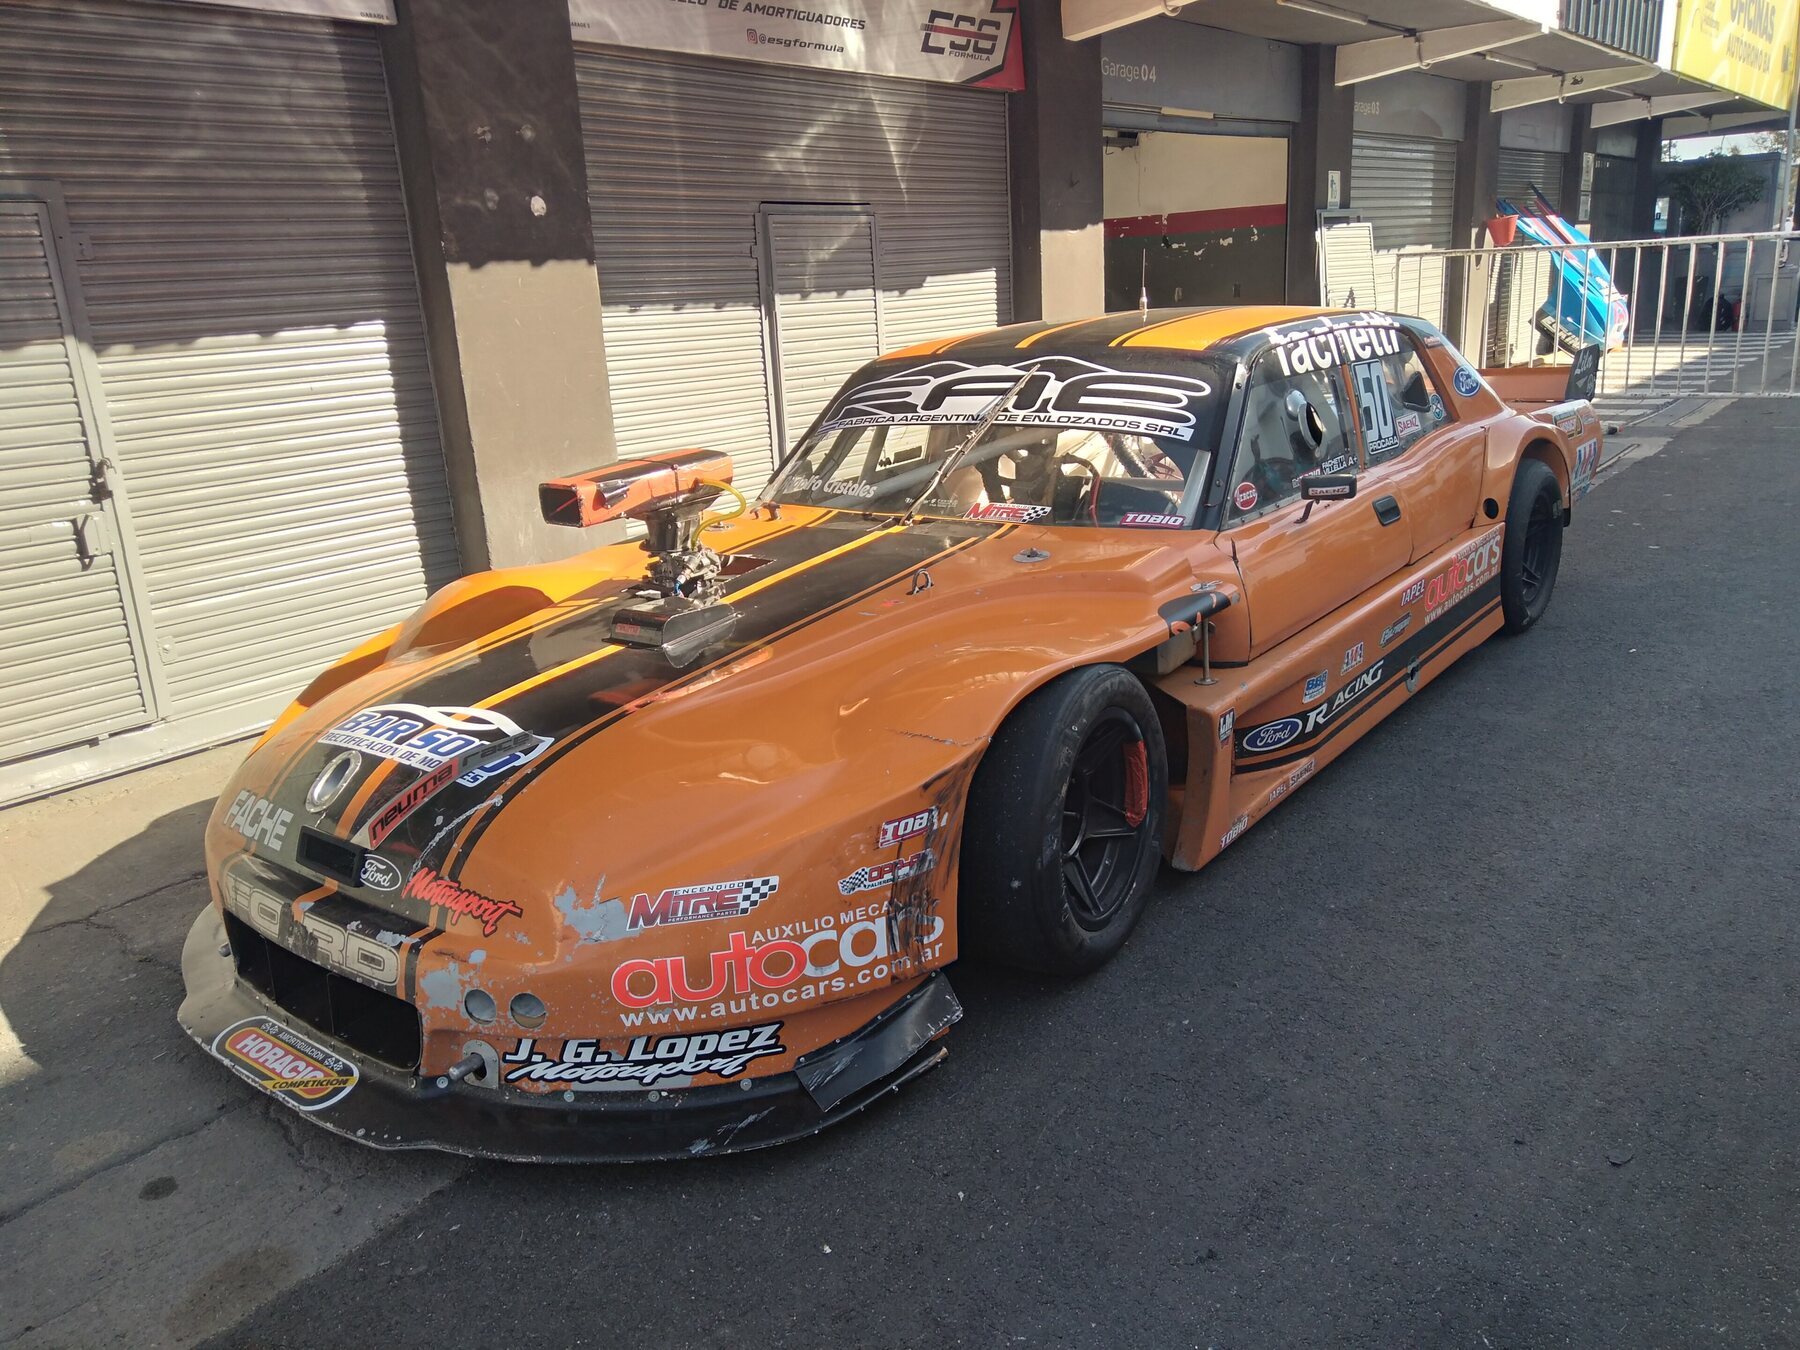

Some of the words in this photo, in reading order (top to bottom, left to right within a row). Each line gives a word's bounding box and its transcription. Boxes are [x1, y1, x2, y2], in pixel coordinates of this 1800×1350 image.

[743, 1, 866, 30] AMORTIGUADORES
[758, 32, 845, 54] @esgformula
[949, 50, 991, 62] FORMULA
[1101, 56, 1140, 82] Garage
[1141, 63, 1157, 83] 04
[1353, 101, 1371, 115] arage
[838, 416, 898, 428] FABRICA
[996, 413, 1019, 422] DE
[1021, 413, 1141, 430] ENLOZADOS
[1144, 423, 1185, 438] SRL
[1397, 415, 1420, 433] SAENZ
[823, 479, 878, 498] Cristales
[1310, 486, 1348, 496] SAENZ
[966, 502, 1030, 520] MITRE
[1125, 513, 1185, 526] TOBIO
[1424, 534, 1501, 612] autocars
[1424, 565, 1498, 625] www.autocars.com.ar
[1305, 660, 1385, 734] RACING
[334, 711, 423, 742] BAR
[1255, 722, 1294, 747] Ford
[324, 732, 401, 757] RECTIFICACION
[400, 750, 418, 762] DE
[371, 764, 453, 840] neuma
[223, 790, 295, 852] FACHE
[360, 858, 393, 889] Ford
[674, 881, 744, 896] ENCENDIDO
[402, 867, 522, 935] Motorsport
[628, 888, 744, 930] MITRE
[667, 913, 714, 923] PERFORMANCE
[716, 909, 737, 917] PARTS
[226, 872, 400, 987] FORD
[752, 914, 835, 945] AUXILIO
[611, 913, 945, 1008] autocars
[620, 940, 943, 1028] www.autocars.com.ar
[235, 1033, 325, 1081] HORACIO
[277, 1030, 325, 1061] AMORTIGUACION
[505, 1037, 543, 1063] J.
[562, 1038, 609, 1063] G.
[628, 1022, 781, 1063] Lopez
[506, 1047, 784, 1084] Motorsport
[272, 1077, 350, 1090] COMPETICION
